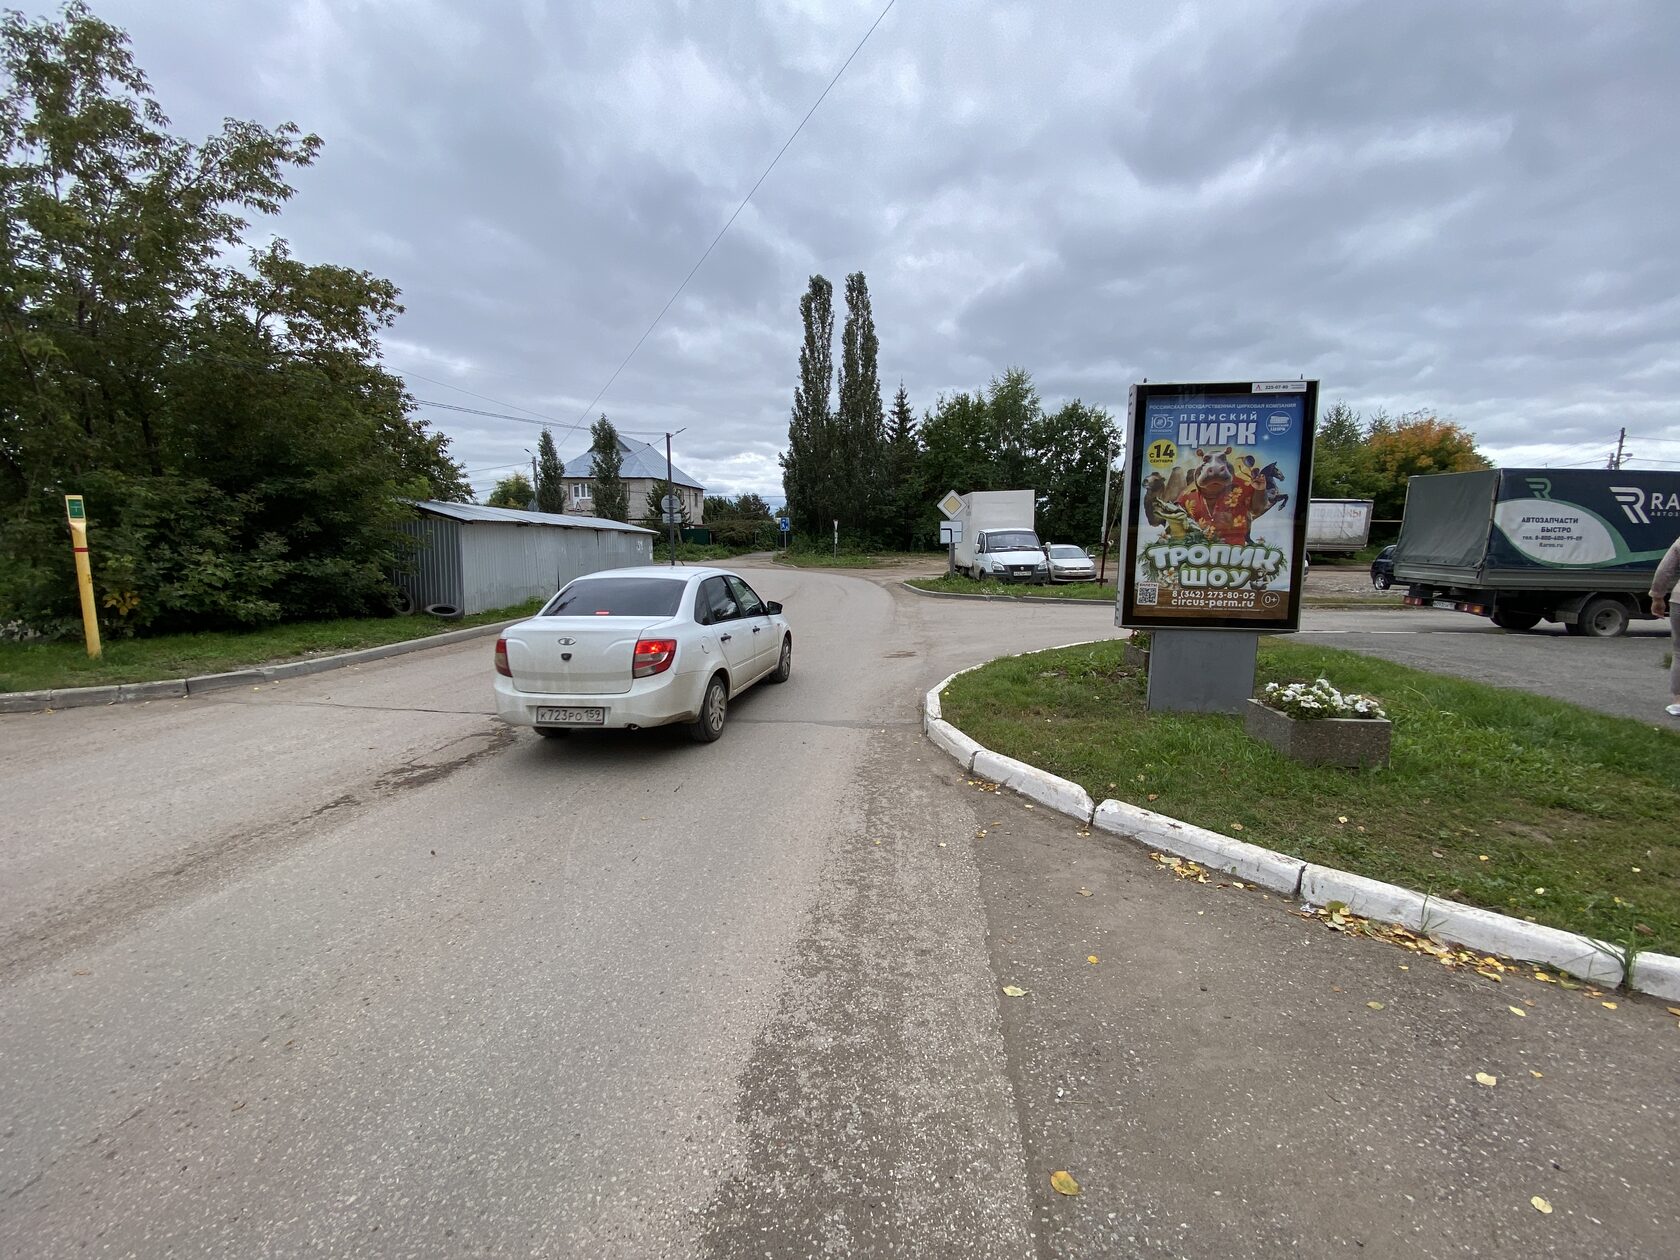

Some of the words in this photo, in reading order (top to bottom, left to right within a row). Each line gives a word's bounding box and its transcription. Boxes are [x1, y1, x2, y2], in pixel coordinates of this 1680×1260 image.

[1180, 411, 1257, 421] ПЕРМСКИЙ
[1178, 422, 1257, 449] ЦИРК
[1153, 444, 1175, 459] 14
[1521, 516, 1579, 524] АВТОЗАПЧАСТИ
[1147, 545, 1281, 571] ТРОПИК
[1181, 568, 1250, 587] ШОУ
[1172, 590, 1178, 598] 8
[1180, 590, 1205, 599] (342)
[1207, 591, 1256, 600] 273-80-02
[1264, 595, 1278, 604] 0+
[1171, 596, 1254, 608] circus-perm.ru
